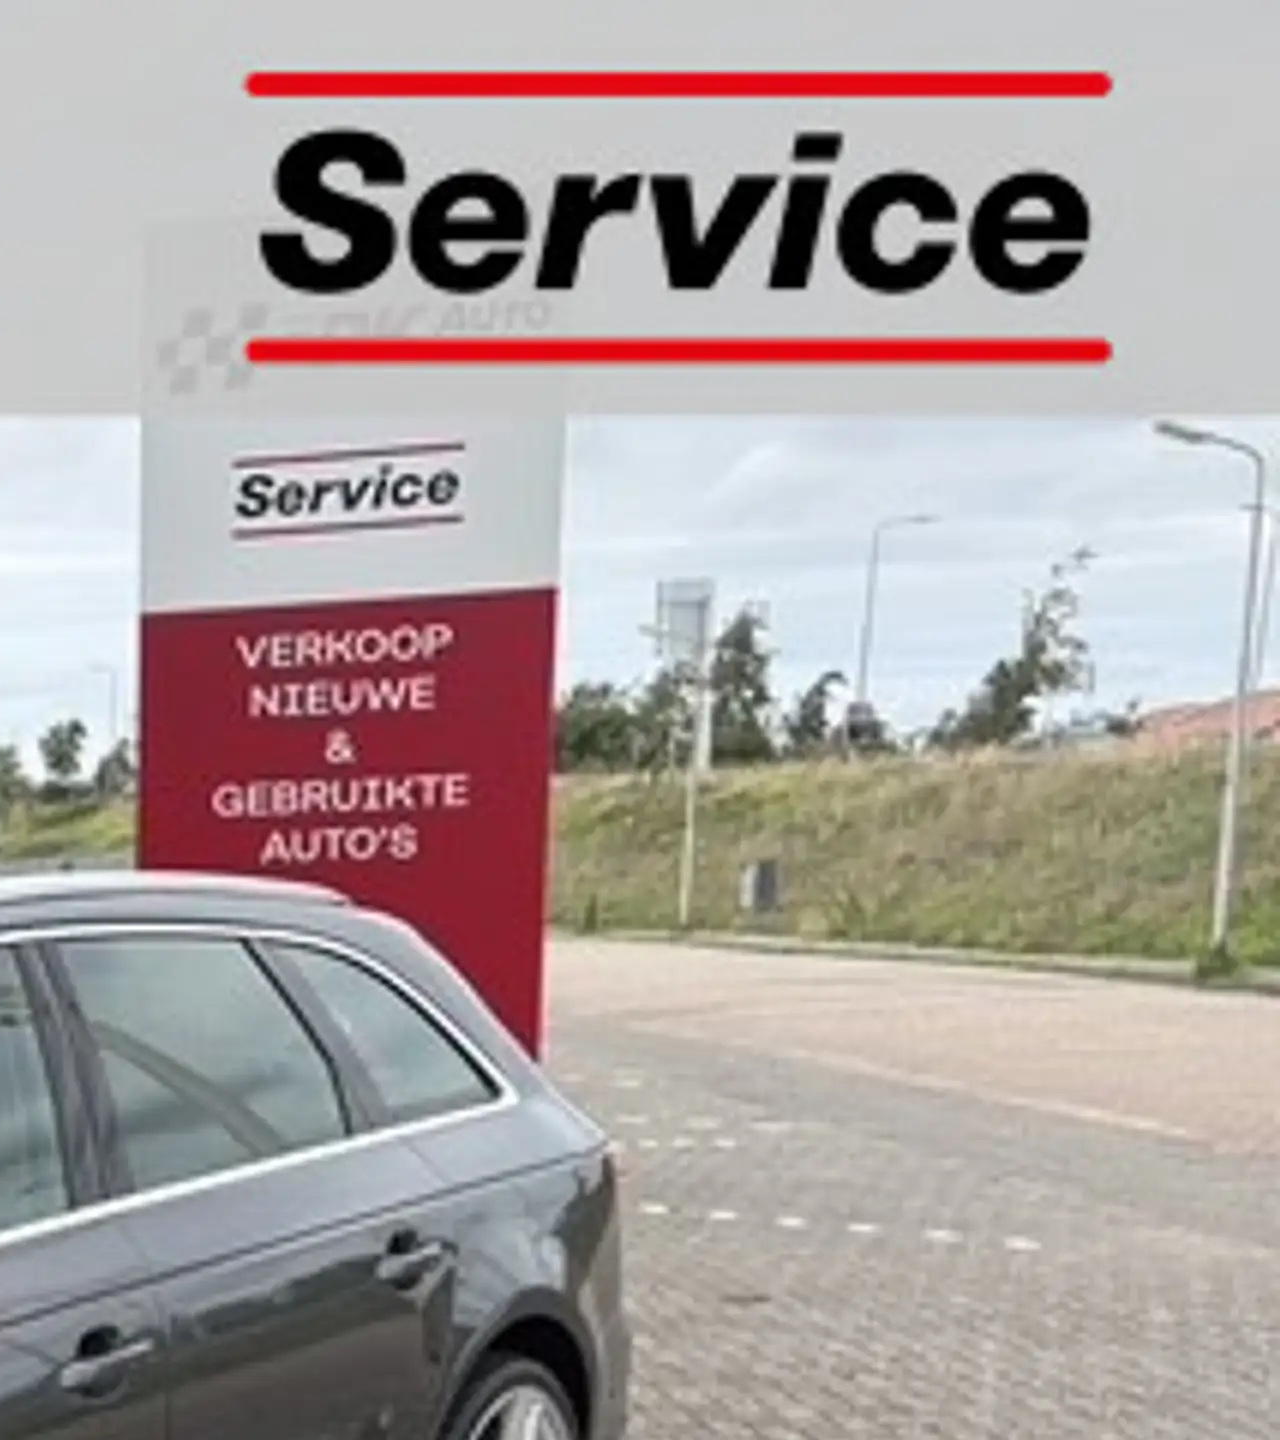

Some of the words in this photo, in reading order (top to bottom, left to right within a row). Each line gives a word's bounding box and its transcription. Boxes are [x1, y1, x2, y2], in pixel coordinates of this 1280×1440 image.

[235, 463, 460, 519] Service
[235, 623, 454, 669] VERKOOP
[248, 674, 435, 718] NIEUWE
[324, 728, 355, 764] &
[210, 773, 469, 817] GEBRUIKTE
[259, 824, 418, 865] AUTO'S
